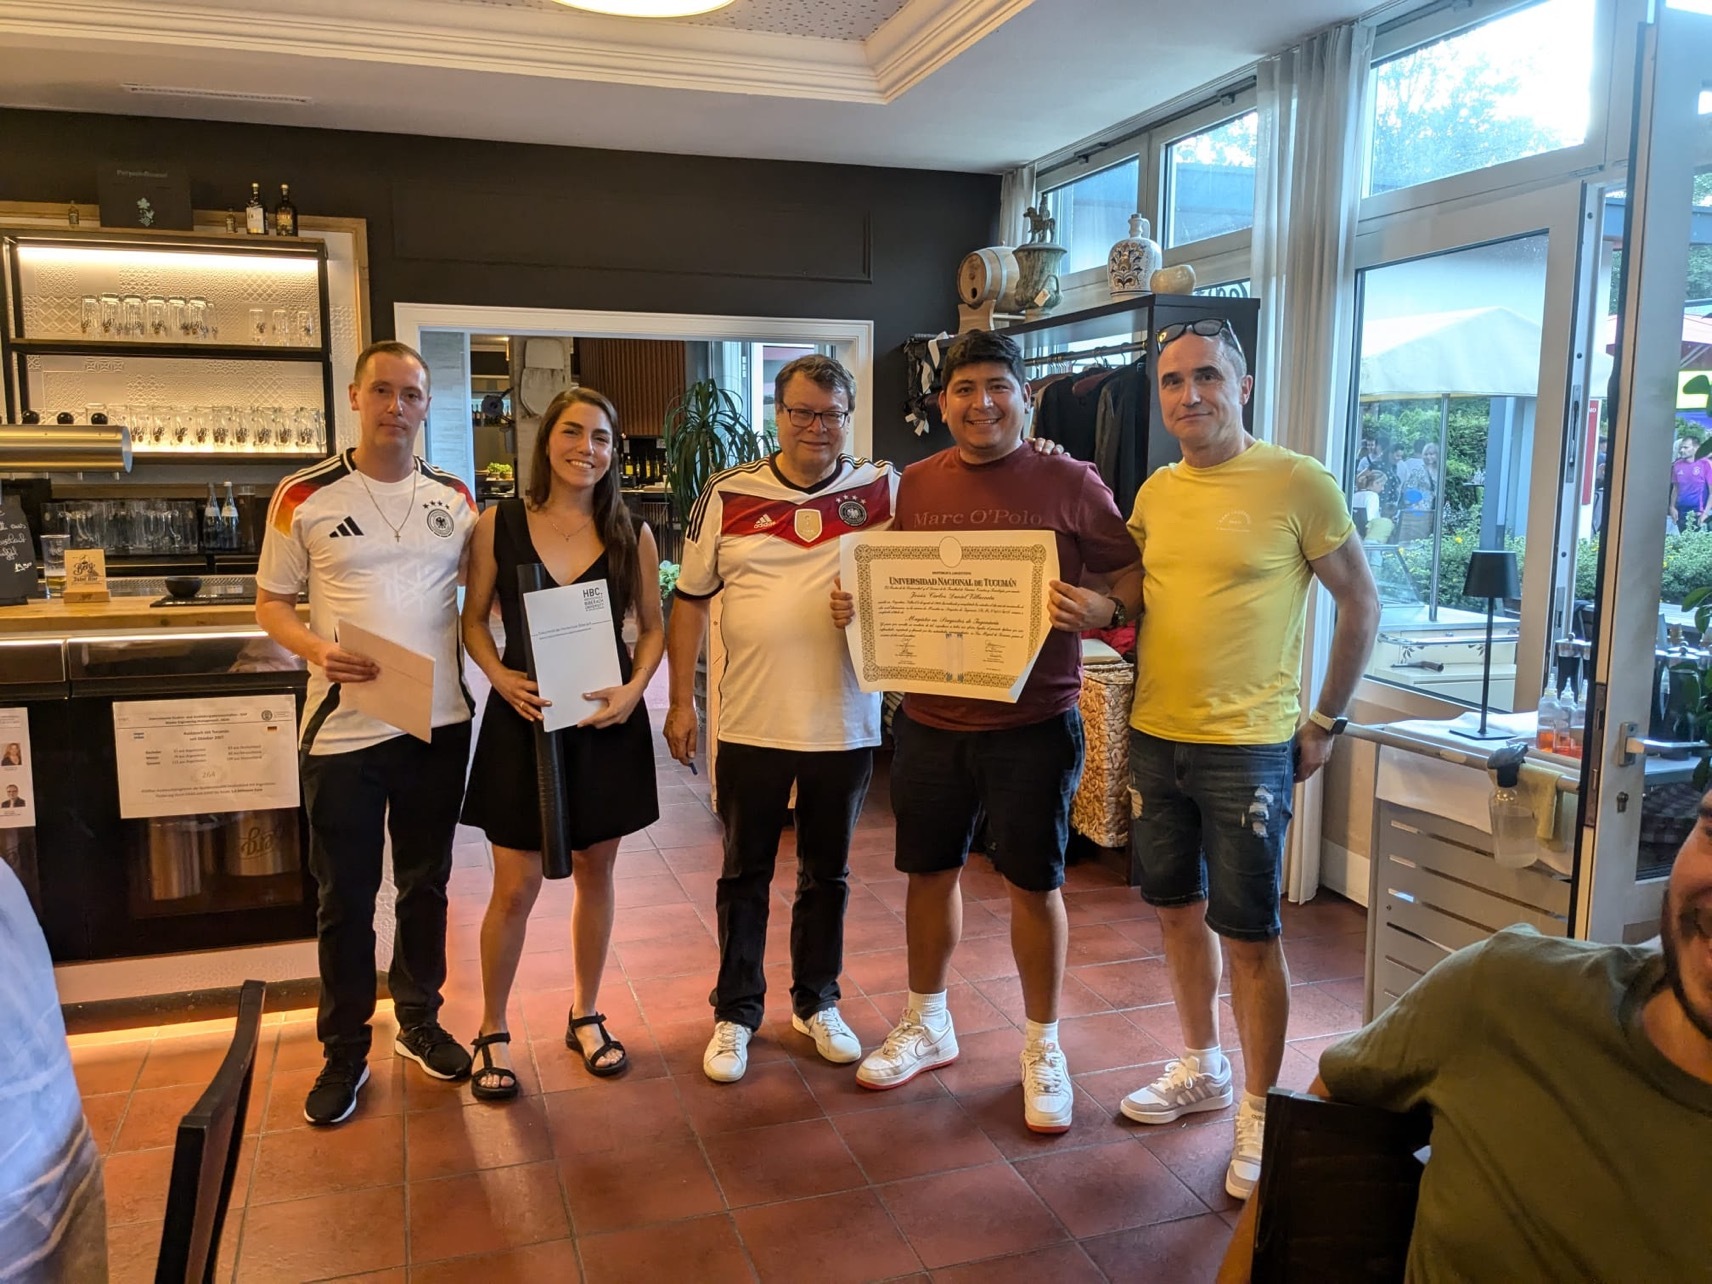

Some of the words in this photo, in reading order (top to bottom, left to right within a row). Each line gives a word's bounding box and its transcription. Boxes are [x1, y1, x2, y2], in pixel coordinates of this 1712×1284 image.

[913, 511, 964, 528] Marc
[970, 509, 1042, 526] O'Polo
[889, 576, 937, 586] UNIVERSIDAD
[938, 577, 973, 587] NACIONAL
[984, 577, 1017, 588] TUCUMÁN
